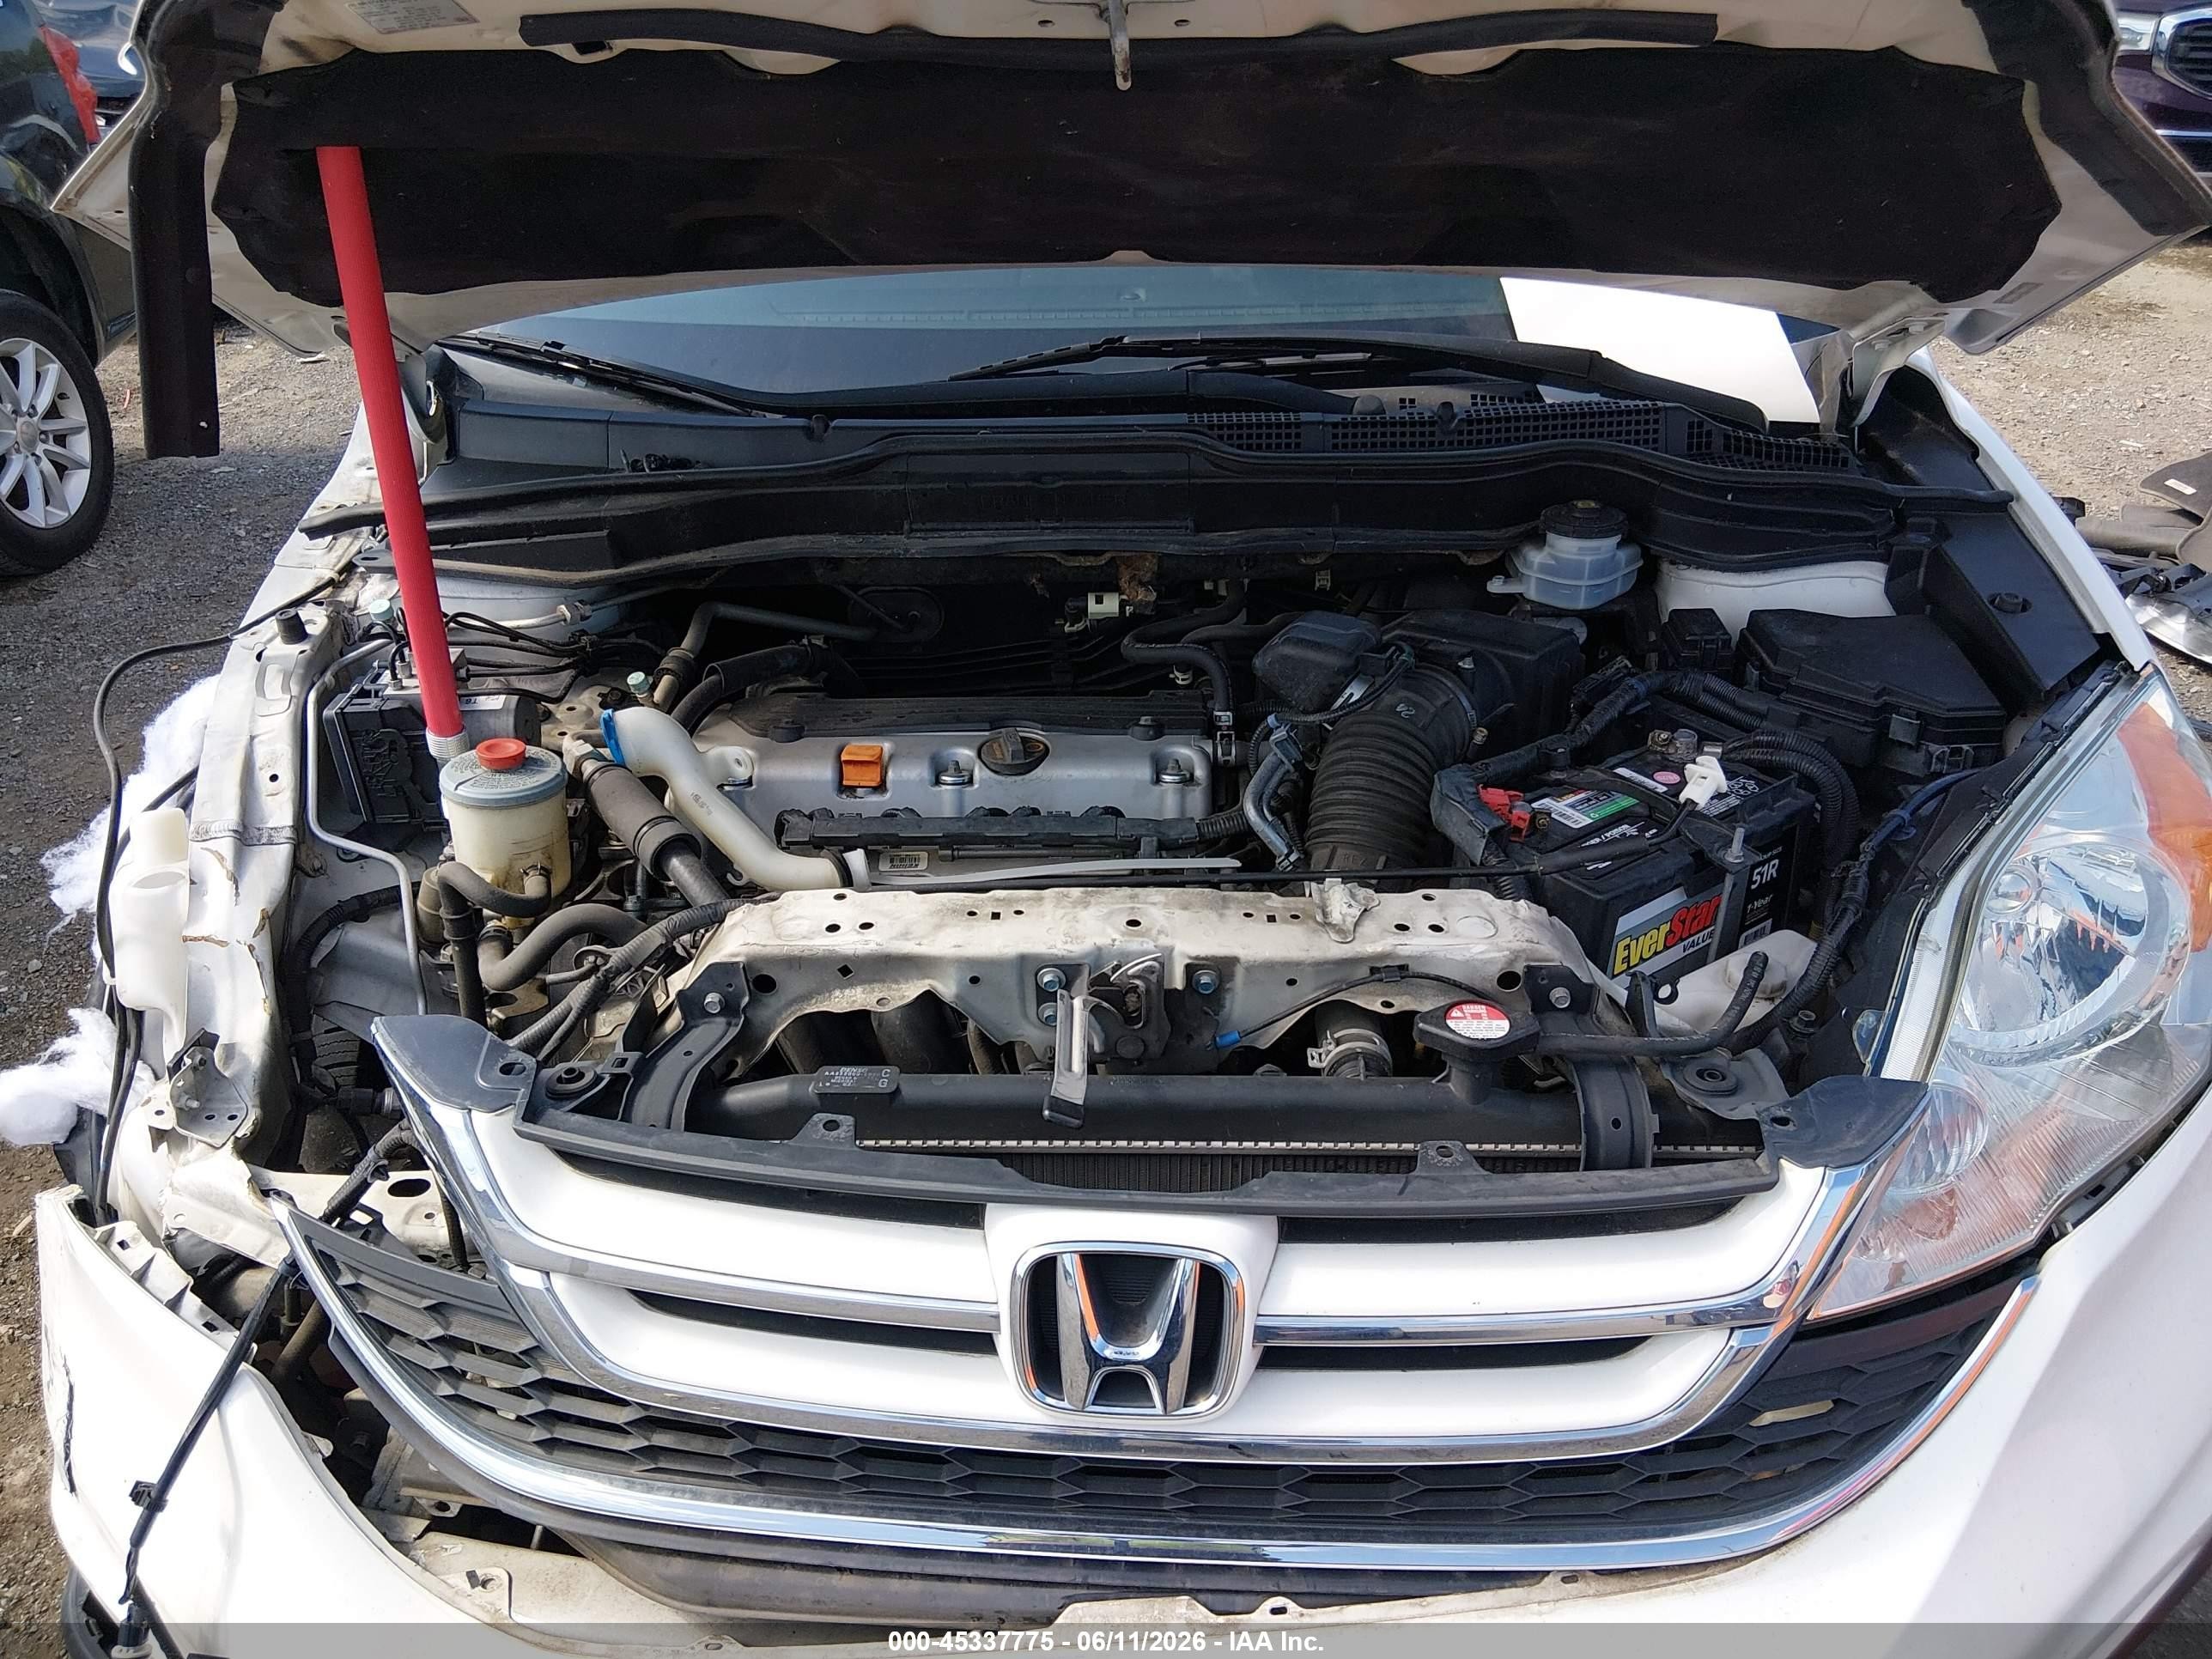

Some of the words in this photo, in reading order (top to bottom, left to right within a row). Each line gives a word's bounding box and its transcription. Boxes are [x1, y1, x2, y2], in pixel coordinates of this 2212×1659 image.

[1751, 859, 1779, 889] 51R
[1613, 894, 1723, 975] EverStar
[1682, 929, 1716, 953] VALUE
